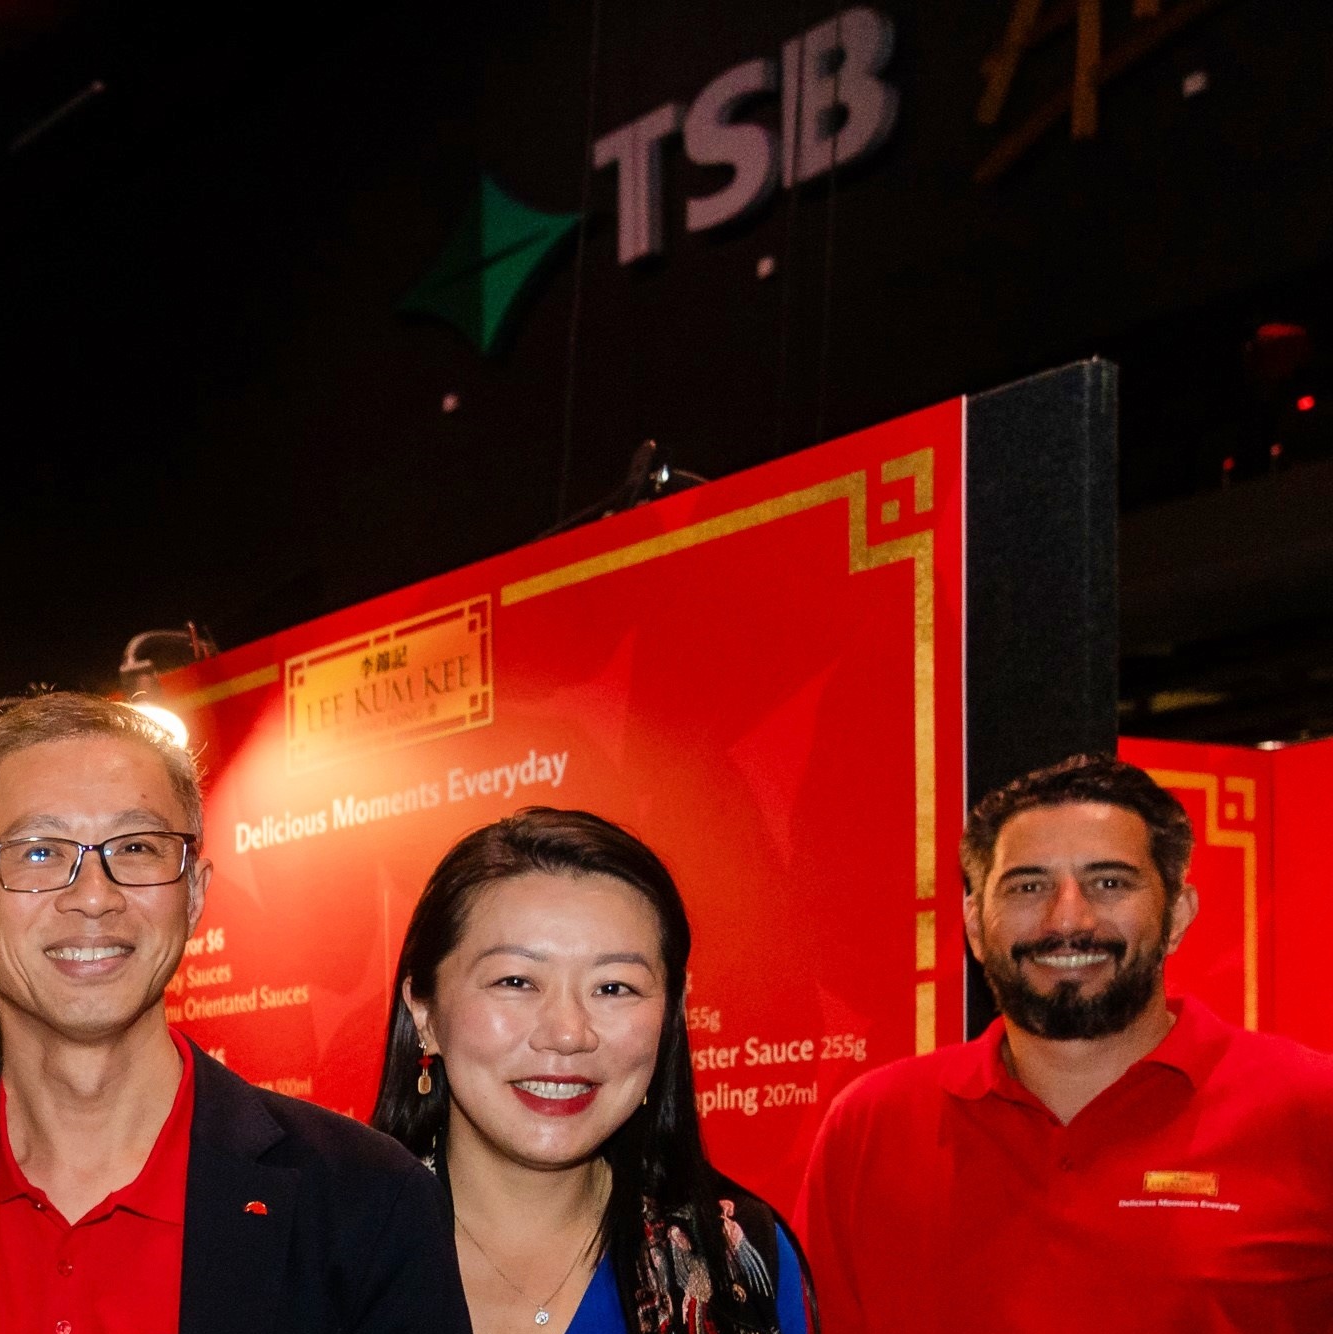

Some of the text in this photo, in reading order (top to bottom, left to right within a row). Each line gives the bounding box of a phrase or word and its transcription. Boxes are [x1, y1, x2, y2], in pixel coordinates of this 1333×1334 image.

[593, 5, 900, 267] TSB
[354, 673, 416, 717] KUM
[422, 653, 471, 698] KEE
[235, 749, 568, 853] Delicious Moments Everyday
[186, 963, 232, 989] Sauces
[183, 986, 258, 1021] Orientated
[259, 984, 309, 1010] Sauces
[744, 1036, 815, 1067] Sauce
[820, 1033, 868, 1062] 255g
[763, 1080, 819, 1108] 207ml
